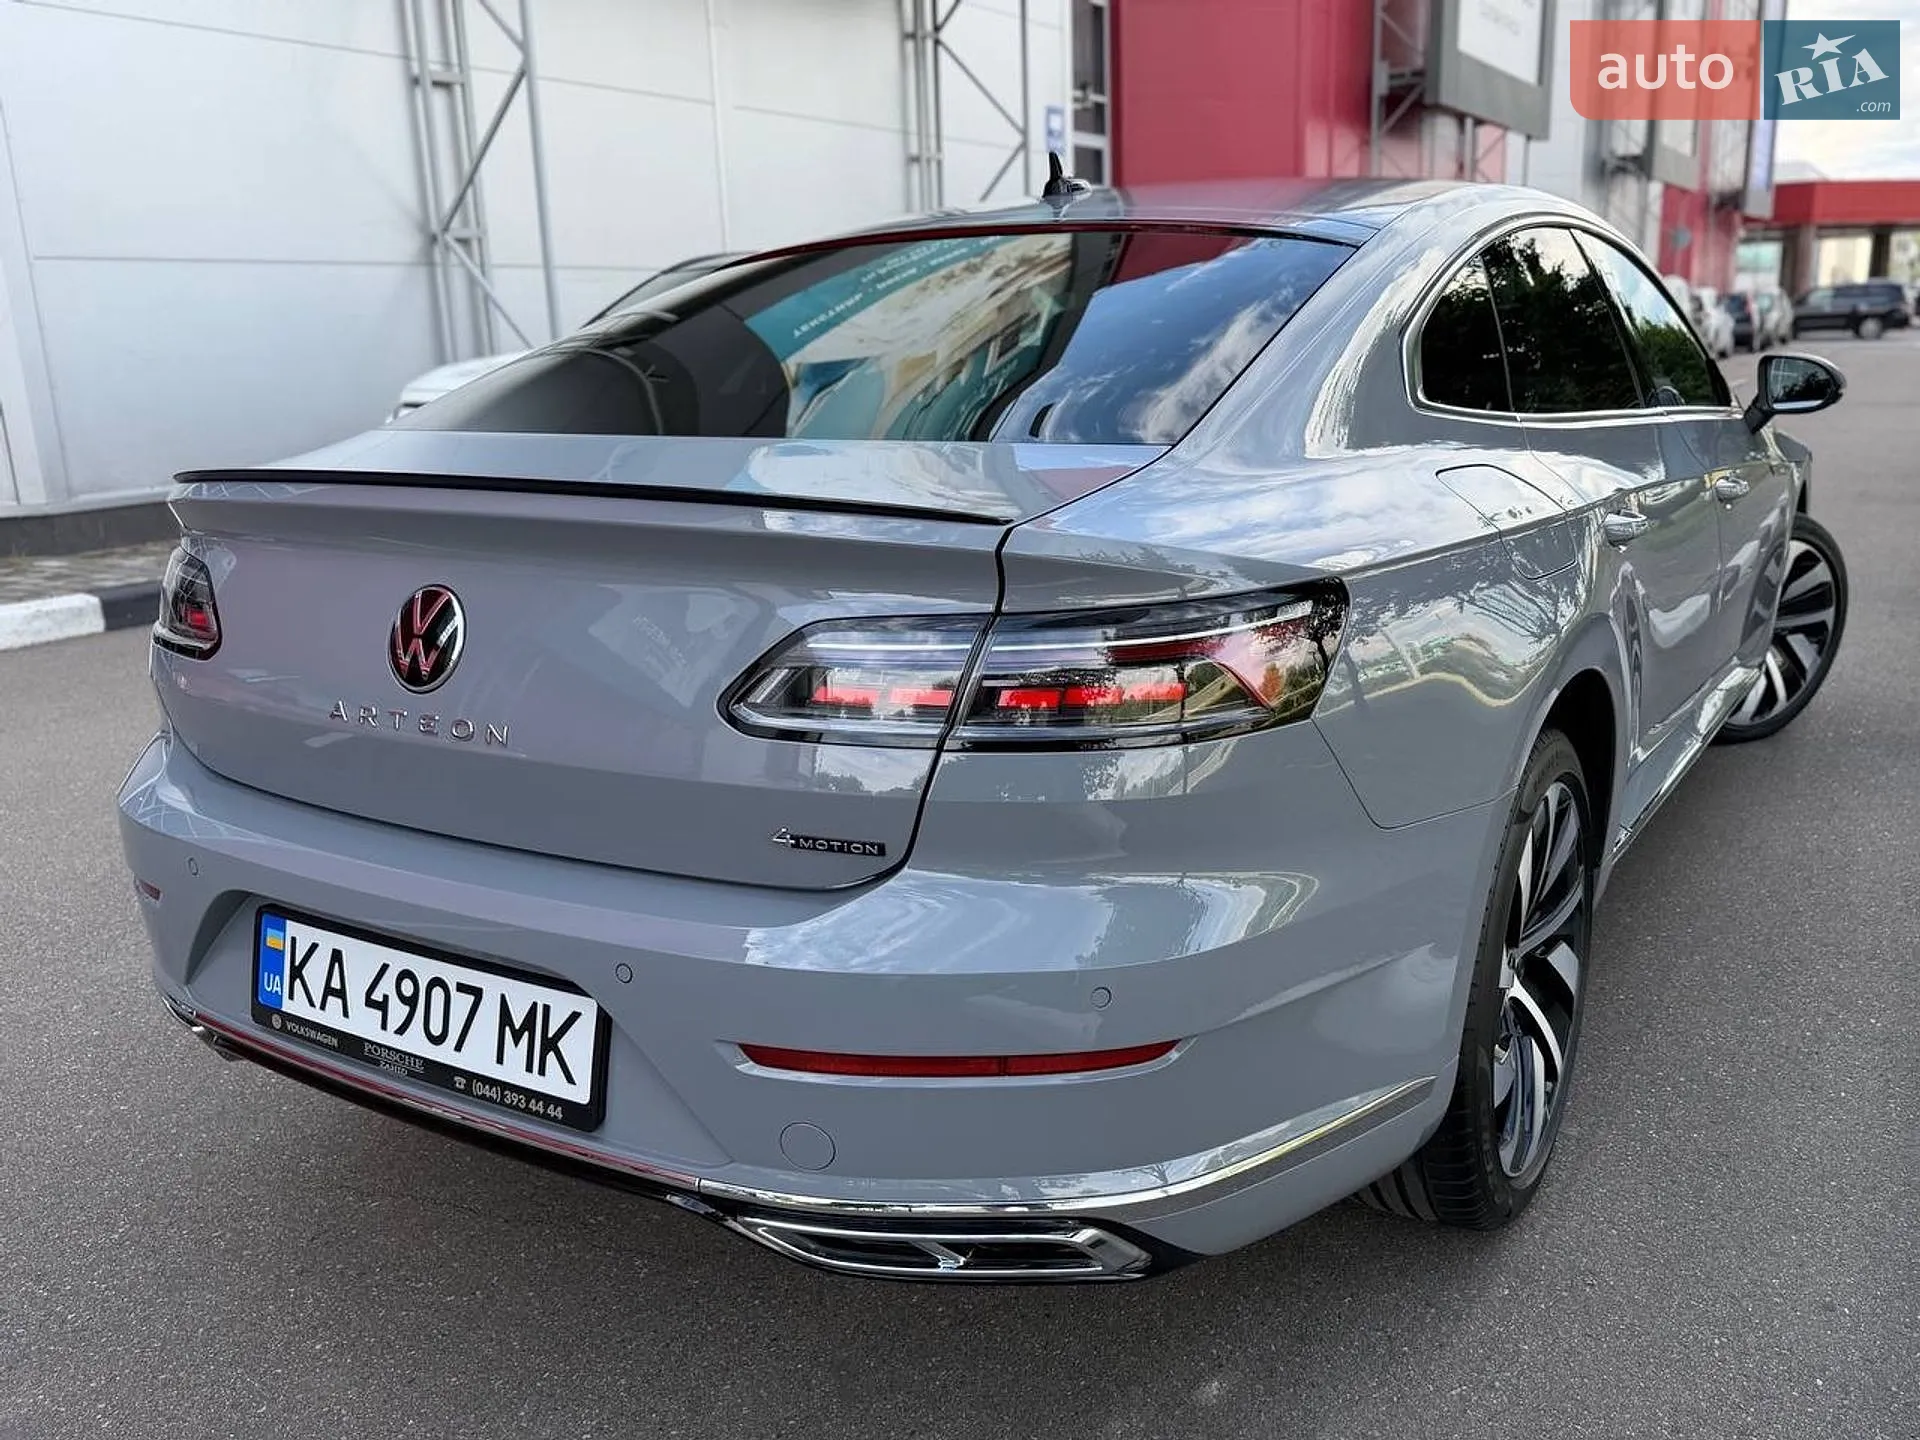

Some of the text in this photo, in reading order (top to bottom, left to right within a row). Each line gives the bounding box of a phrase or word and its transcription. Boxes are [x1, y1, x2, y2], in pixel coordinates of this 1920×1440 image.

[330, 700, 509, 747] ARTEON
[772, 826, 879, 855] 4MOTION
[263, 971, 282, 995] UA
[288, 935, 583, 1086] KA 4907 MK
[285, 1021, 339, 1048] VOLKSWAGEN
[363, 1042, 425, 1071] PORSCHE
[472, 1079, 563, 1120] (044) 393 44 44
